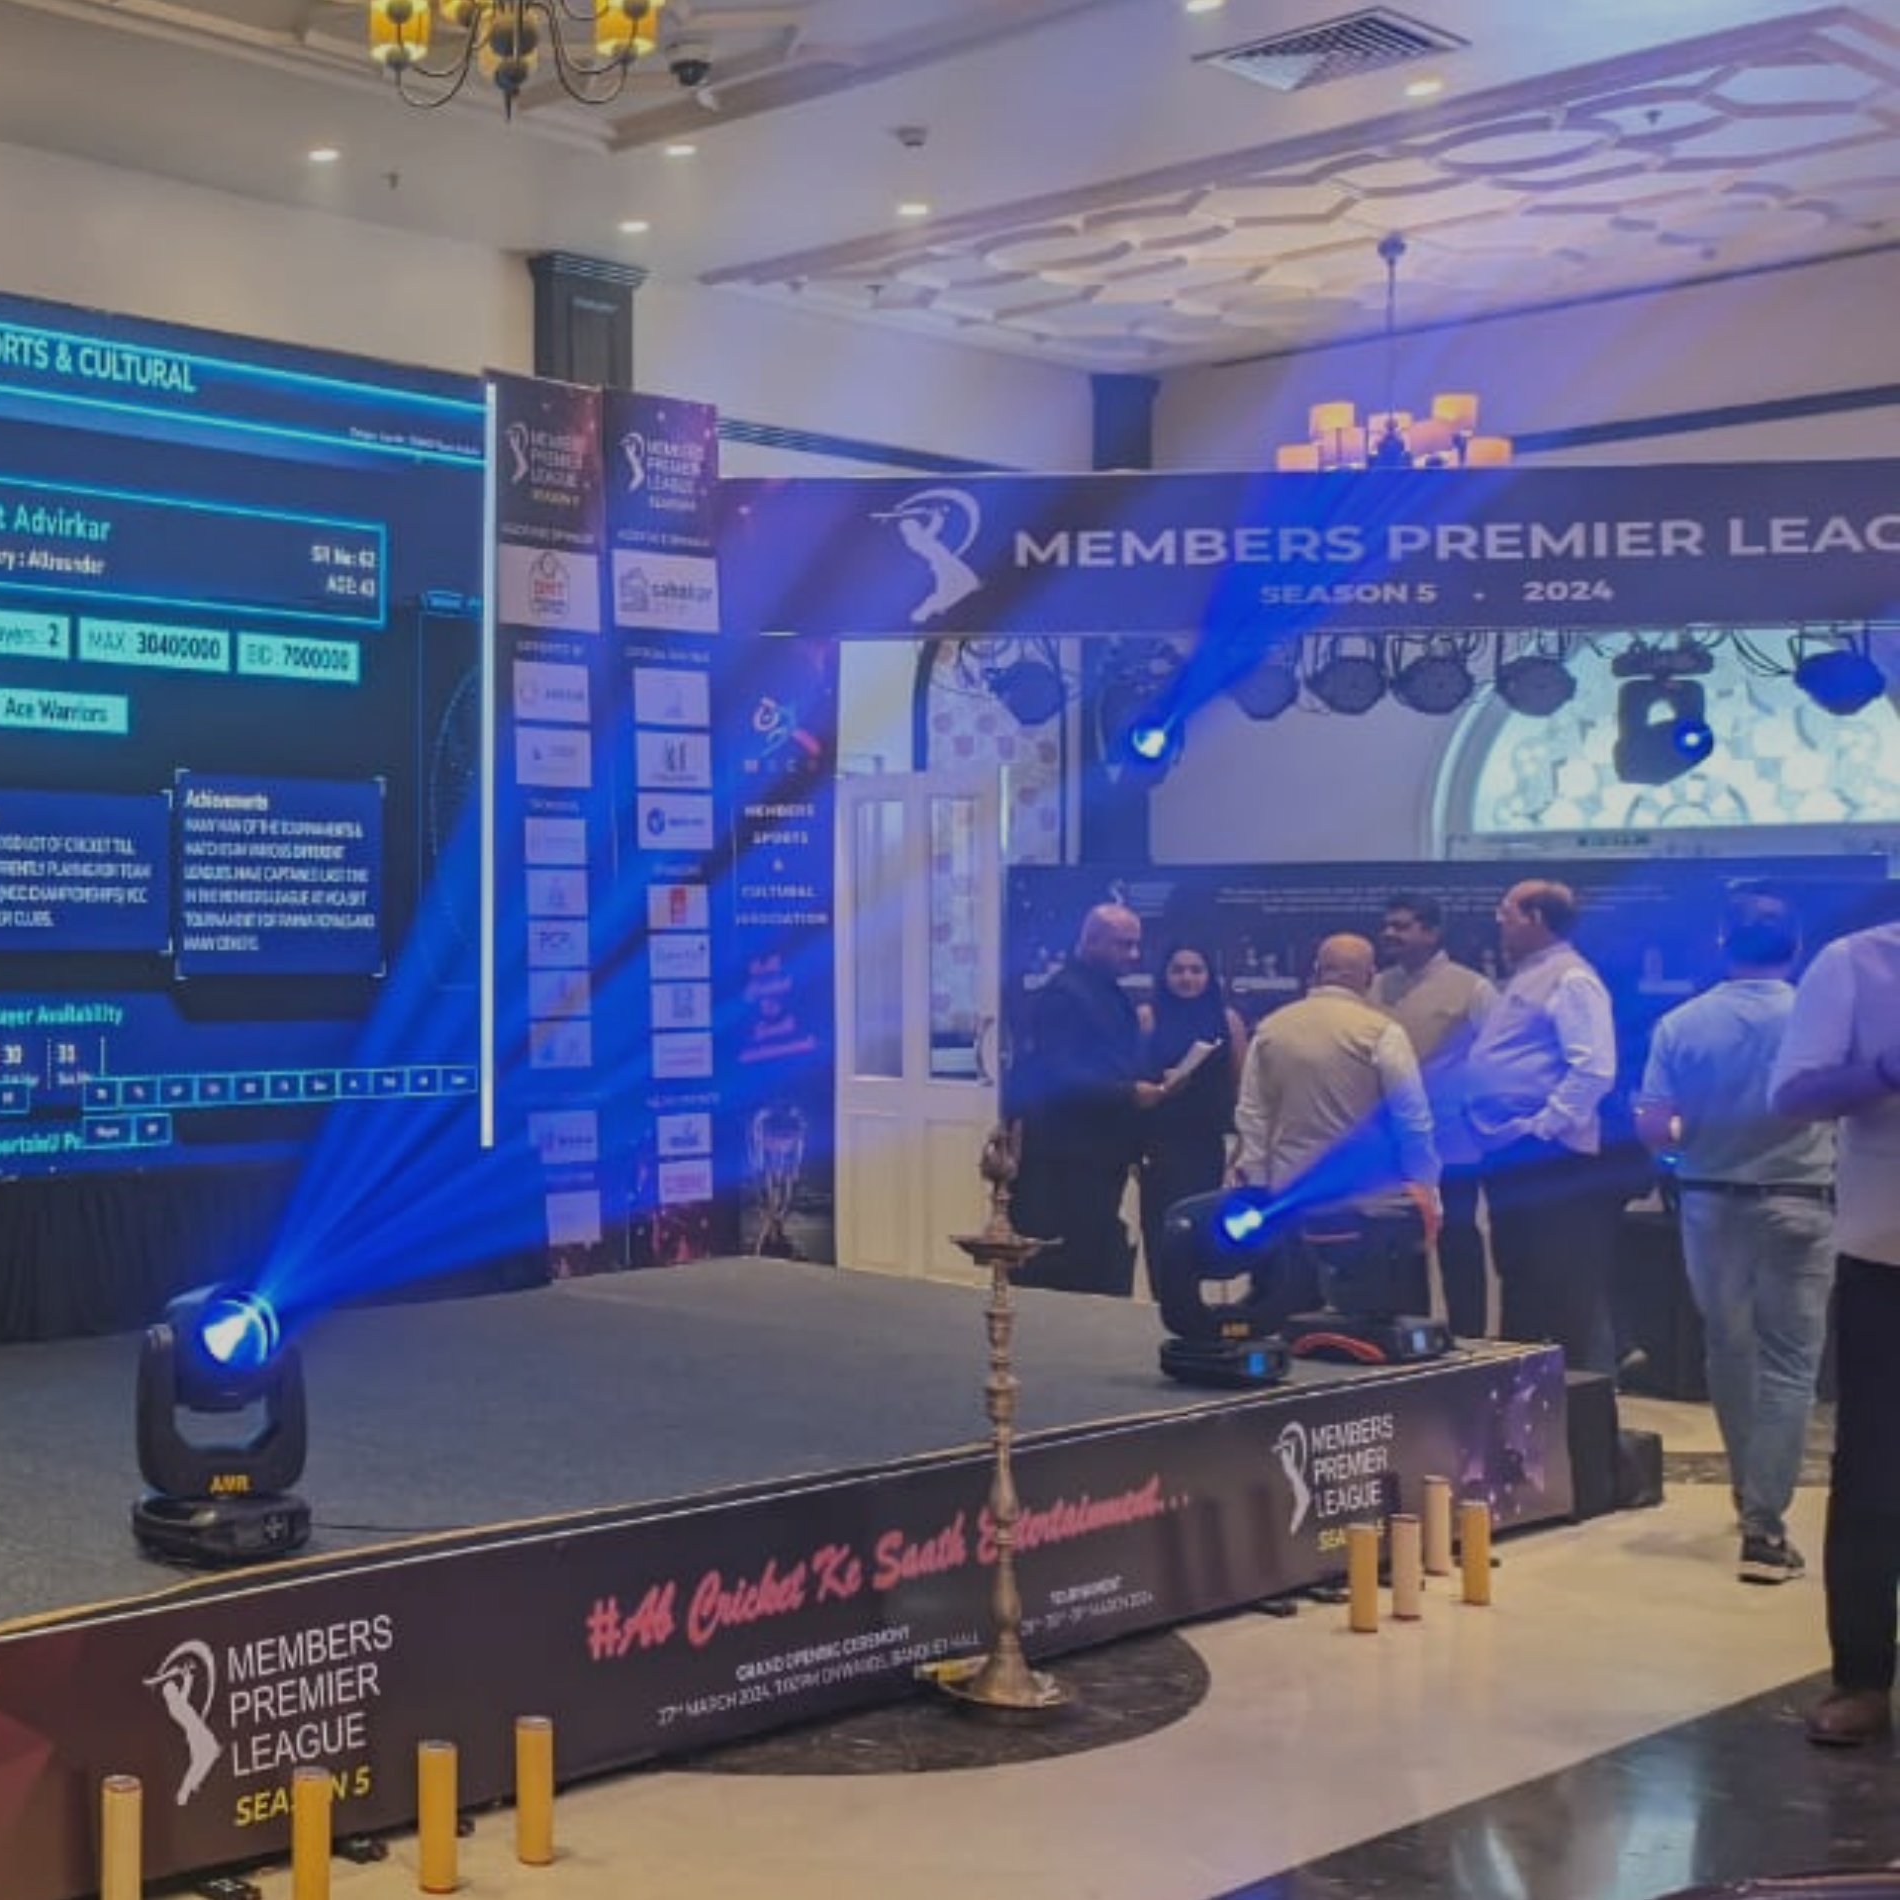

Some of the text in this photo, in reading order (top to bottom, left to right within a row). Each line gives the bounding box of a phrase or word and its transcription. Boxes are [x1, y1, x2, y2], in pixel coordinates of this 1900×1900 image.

[55, 343, 73, 372] &
[78, 349, 197, 394] CULTURAL
[13, 504, 112, 541] Advirkar
[1012, 523, 1364, 570] MEMBERS
[1387, 520, 1703, 563] PREMIER
[27, 549, 105, 575] Allrounder
[1259, 579, 1614, 606] SEASON 5 2024
[48, 624, 60, 647] 2
[136, 632, 222, 660] 30400000
[282, 645, 351, 672] 7000000
[4, 697, 109, 724] Ace Warriors
[185, 788, 269, 811] Achievements
[743, 804, 816, 819] MEMBERS
[752, 830, 809, 845] SPORTS
[741, 885, 817, 899] CULTURAL
[36, 1004, 124, 1027] Availability
[1309, 1413, 1395, 1454] MEMBERS
[1312, 1448, 1388, 1485] PREMIER
[1315, 1481, 1382, 1519] LEAGUE
[1316, 1526, 1347, 1552] SEA
[586, 1473, 1191, 1661] #Ab Cricket Ke Saath Etertainment...
[227, 1613, 394, 1684] MEMBERS
[735, 1624, 911, 1682] GRAND OPENING CEREMONY
[229, 1662, 382, 1729] PREMIER
[684, 1691, 738, 1718] MARCH
[231, 1712, 368, 1779] LEAGUE
[234, 1765, 372, 1827] SEAN 5
